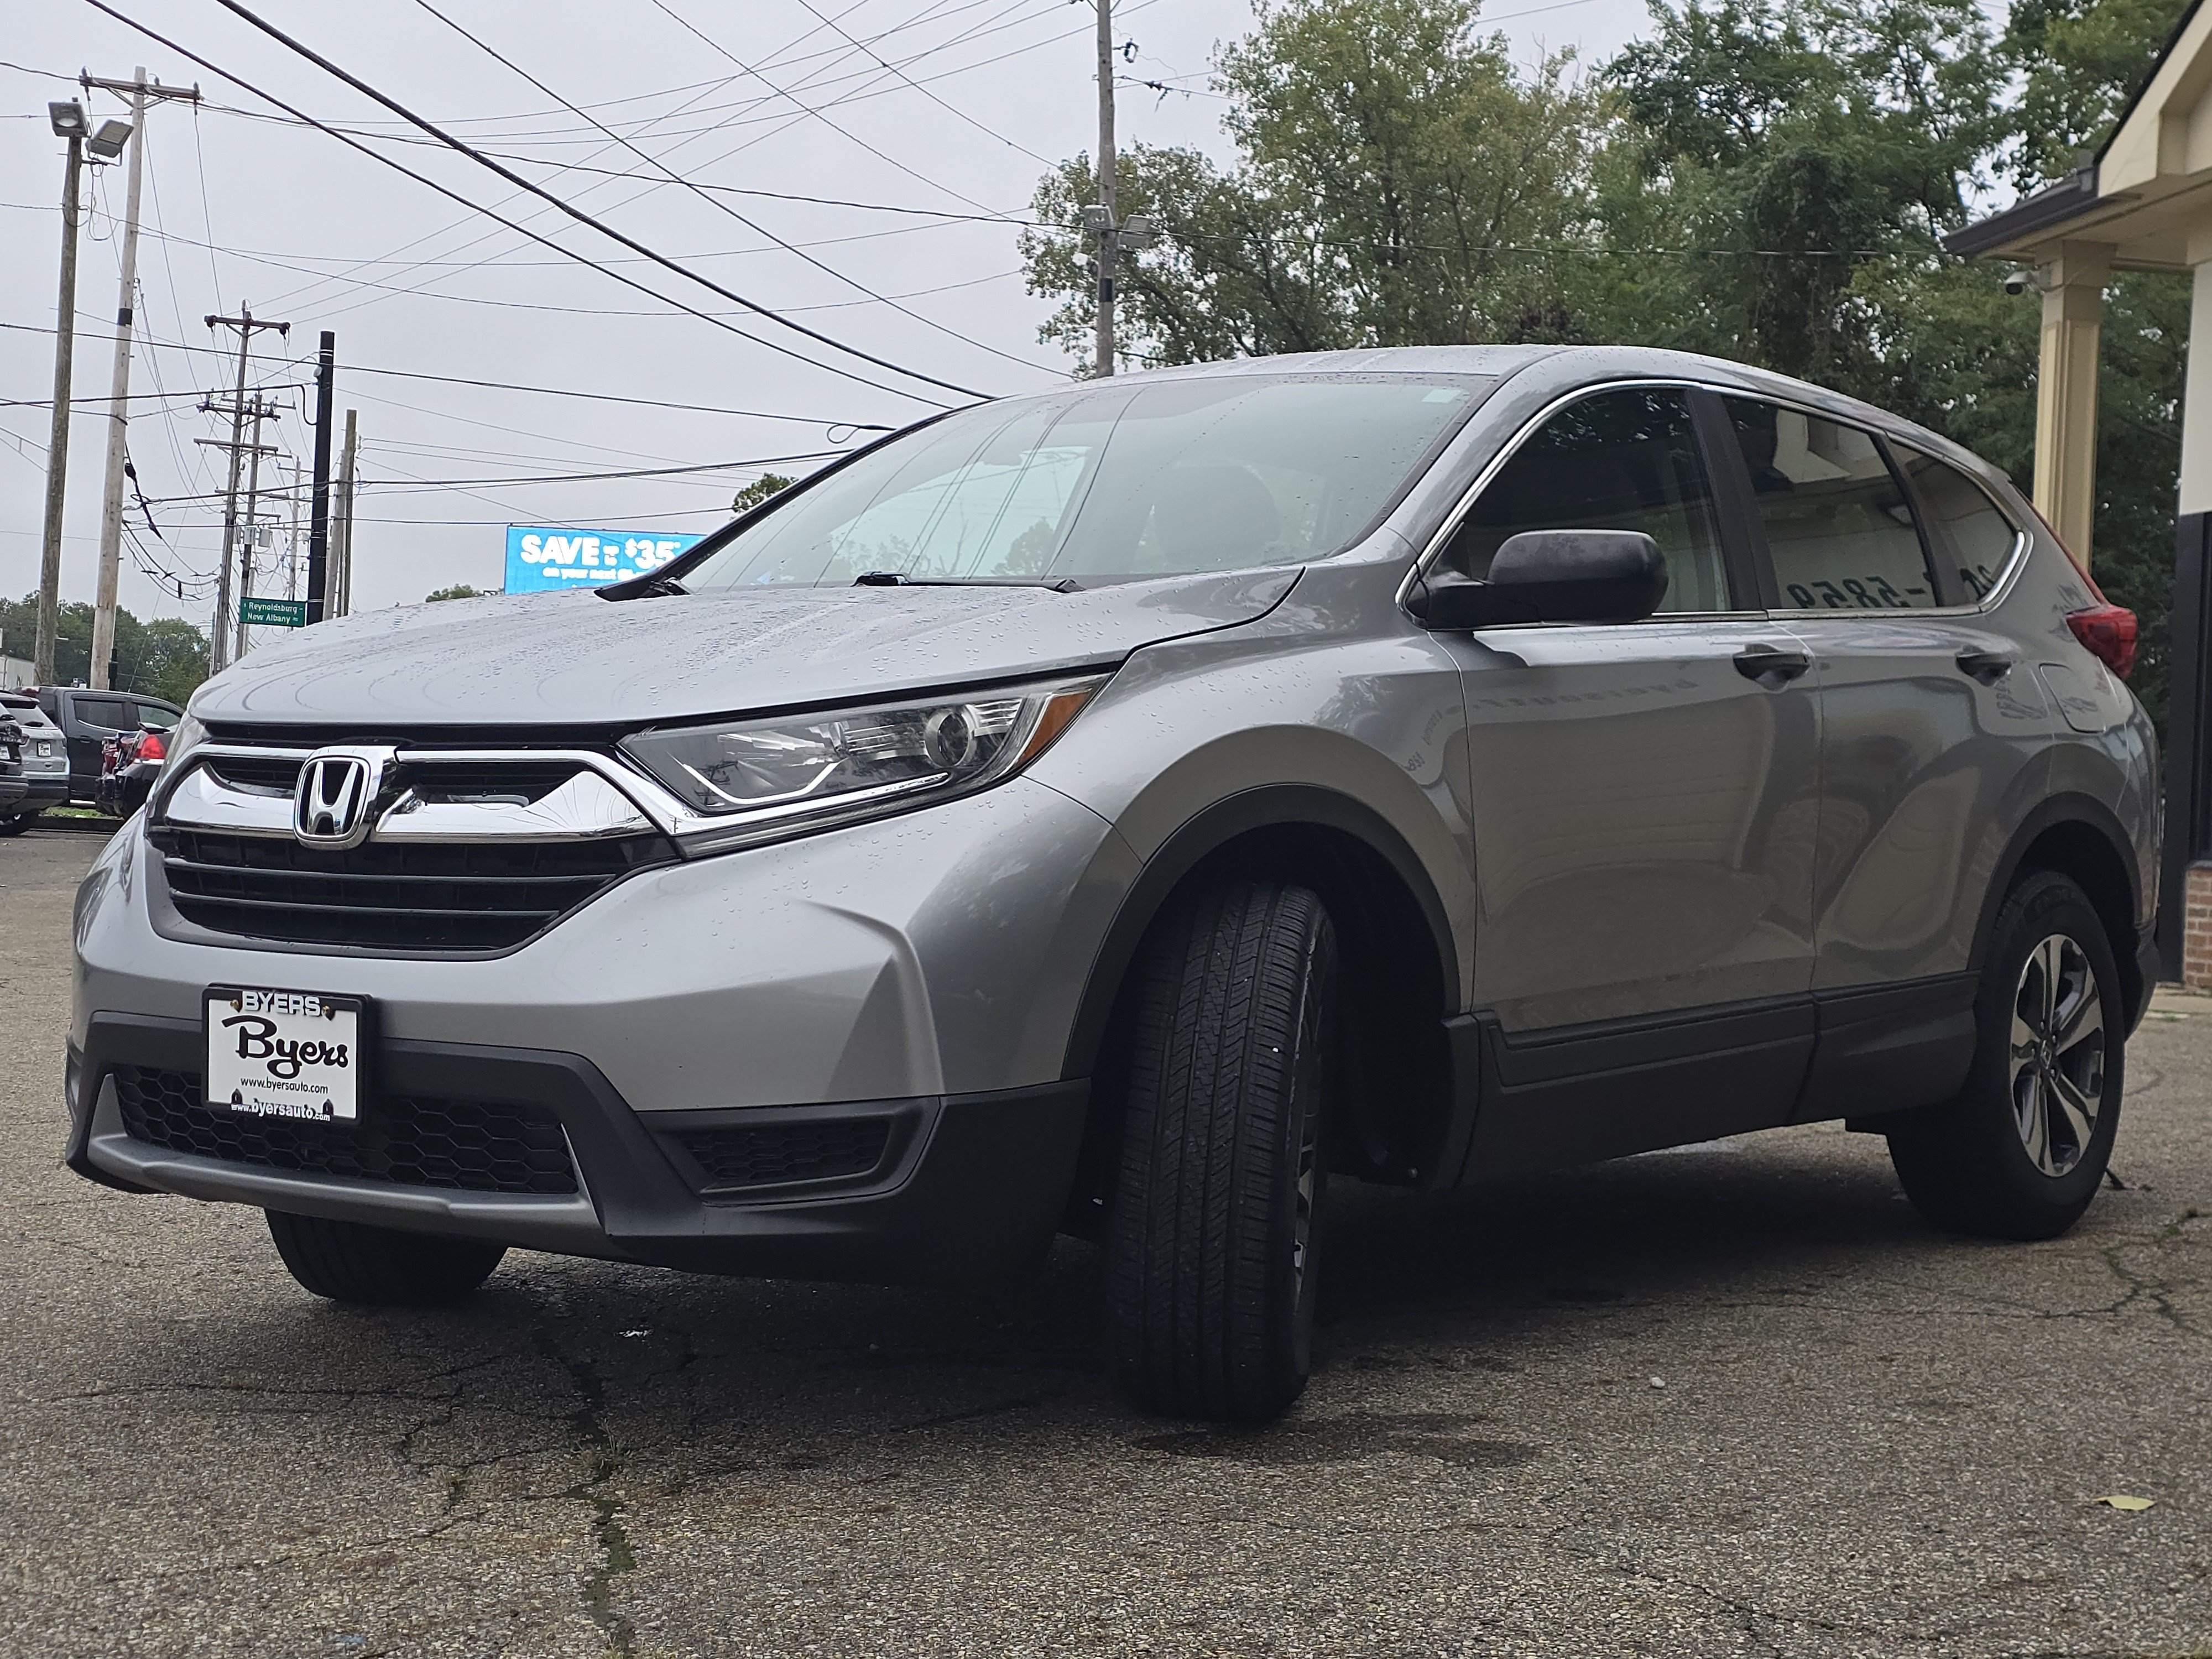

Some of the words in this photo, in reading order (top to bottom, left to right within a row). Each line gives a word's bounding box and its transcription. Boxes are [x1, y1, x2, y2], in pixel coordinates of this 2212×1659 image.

[520, 534, 600, 566] SAVE
[247, 612, 264, 620] New
[266, 613, 290, 624] Albany
[249, 602, 297, 614] Reynoldsburg
[242, 991, 321, 1016] BYERS
[221, 1015, 348, 1079] Byers
[241, 1077, 328, 1094] www.byersauto.com
[231, 1099, 330, 1121] www.byersauto.com
